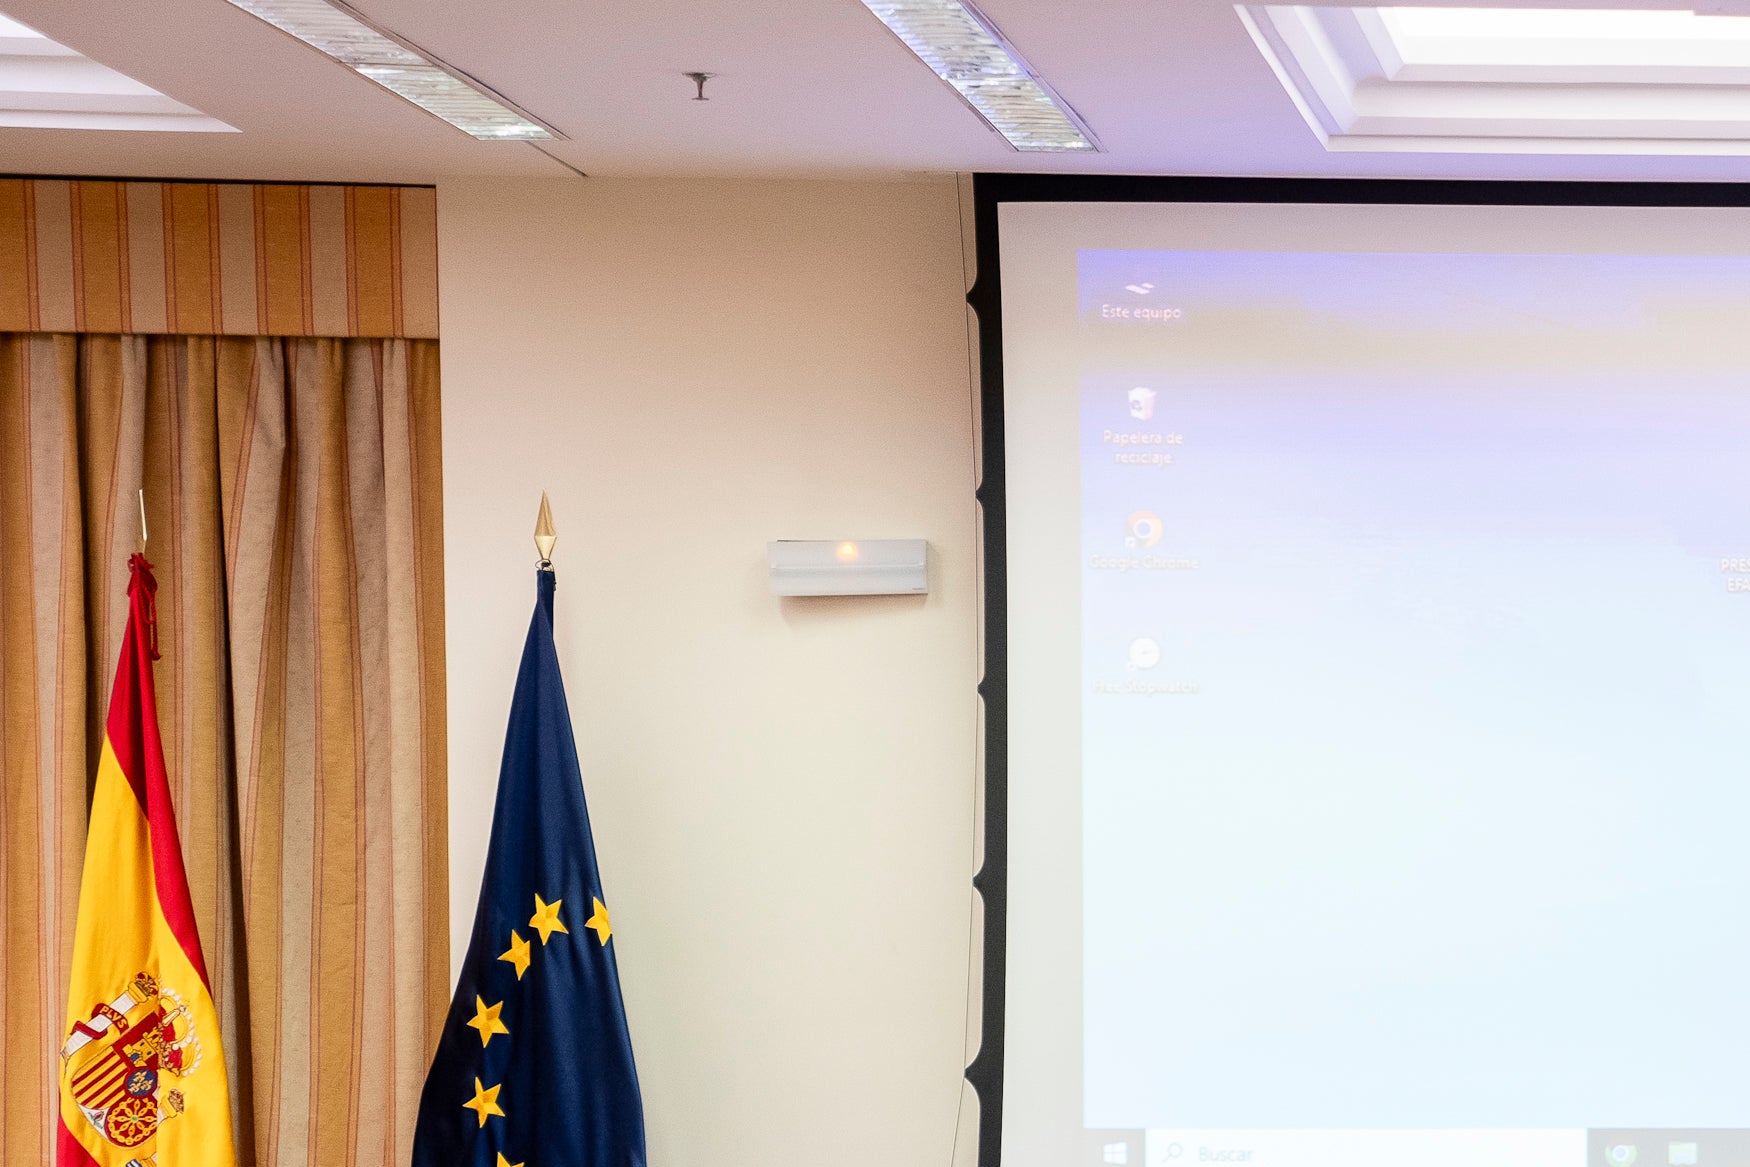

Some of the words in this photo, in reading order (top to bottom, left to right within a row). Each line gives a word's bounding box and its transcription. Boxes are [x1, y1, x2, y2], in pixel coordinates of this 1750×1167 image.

[1102, 304, 1130, 319] Este
[1133, 305, 1182, 321] equipo
[1103, 430, 1162, 447] Papelera
[1166, 430, 1184, 445] de
[99, 1005, 127, 1029] PLVS
[1198, 1146, 1255, 1162] Buscar
